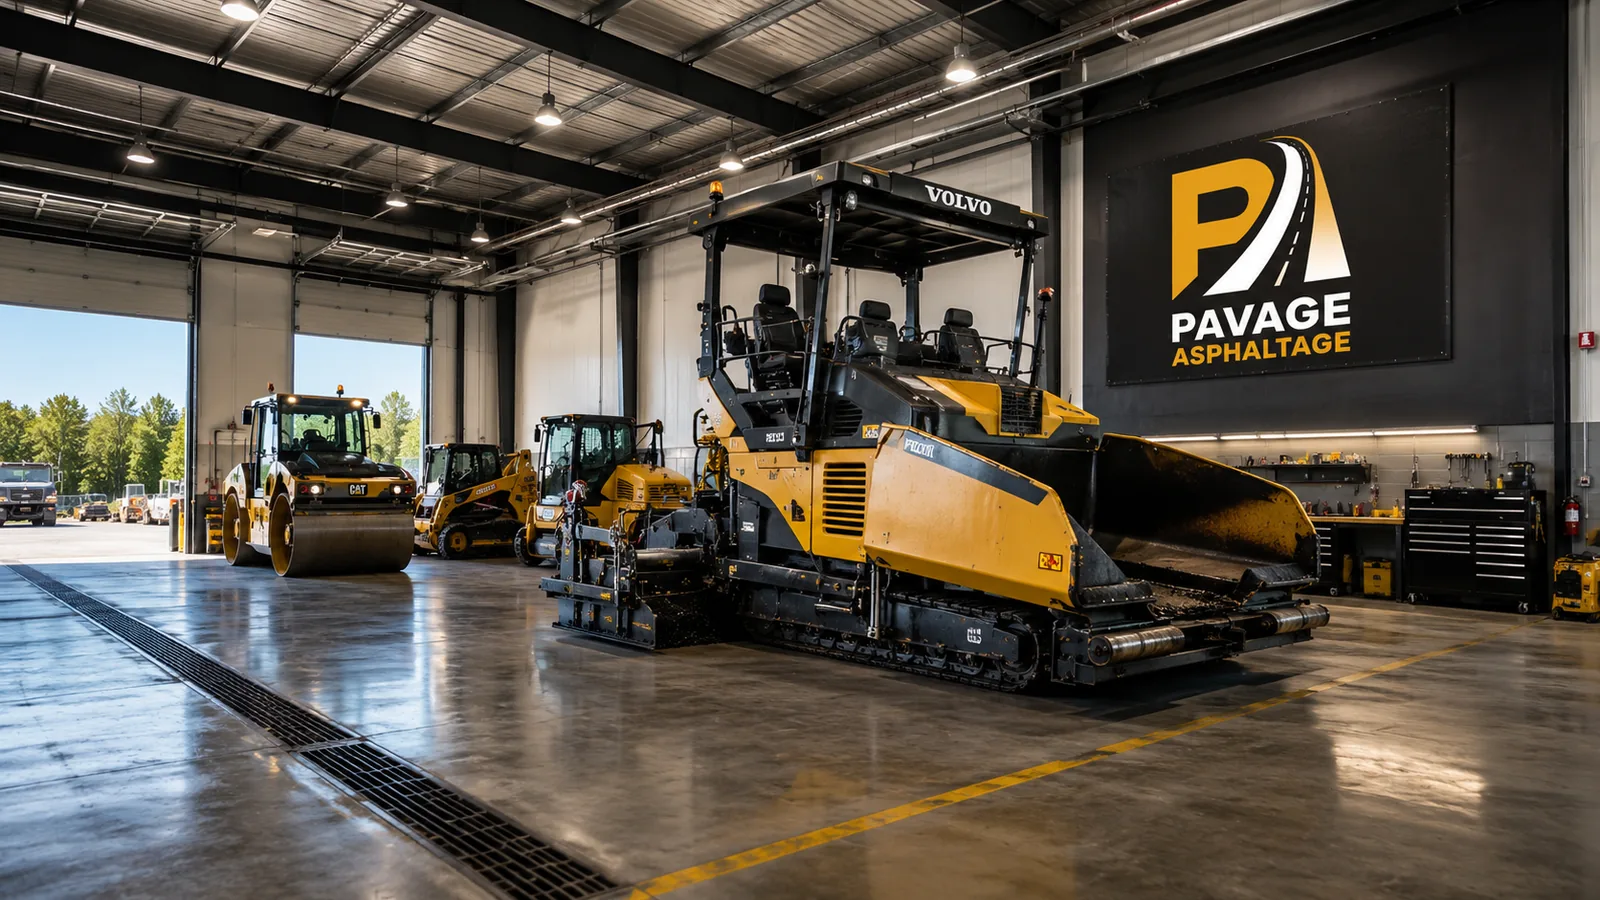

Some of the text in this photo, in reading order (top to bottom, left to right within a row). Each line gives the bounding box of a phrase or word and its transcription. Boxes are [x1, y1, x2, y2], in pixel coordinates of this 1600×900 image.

[924, 184, 992, 216] VOLVO
[1172, 291, 1351, 343] PAVAGE
[1172, 331, 1351, 367] ASPHALTAGE
[349, 484, 367, 495] CAT
